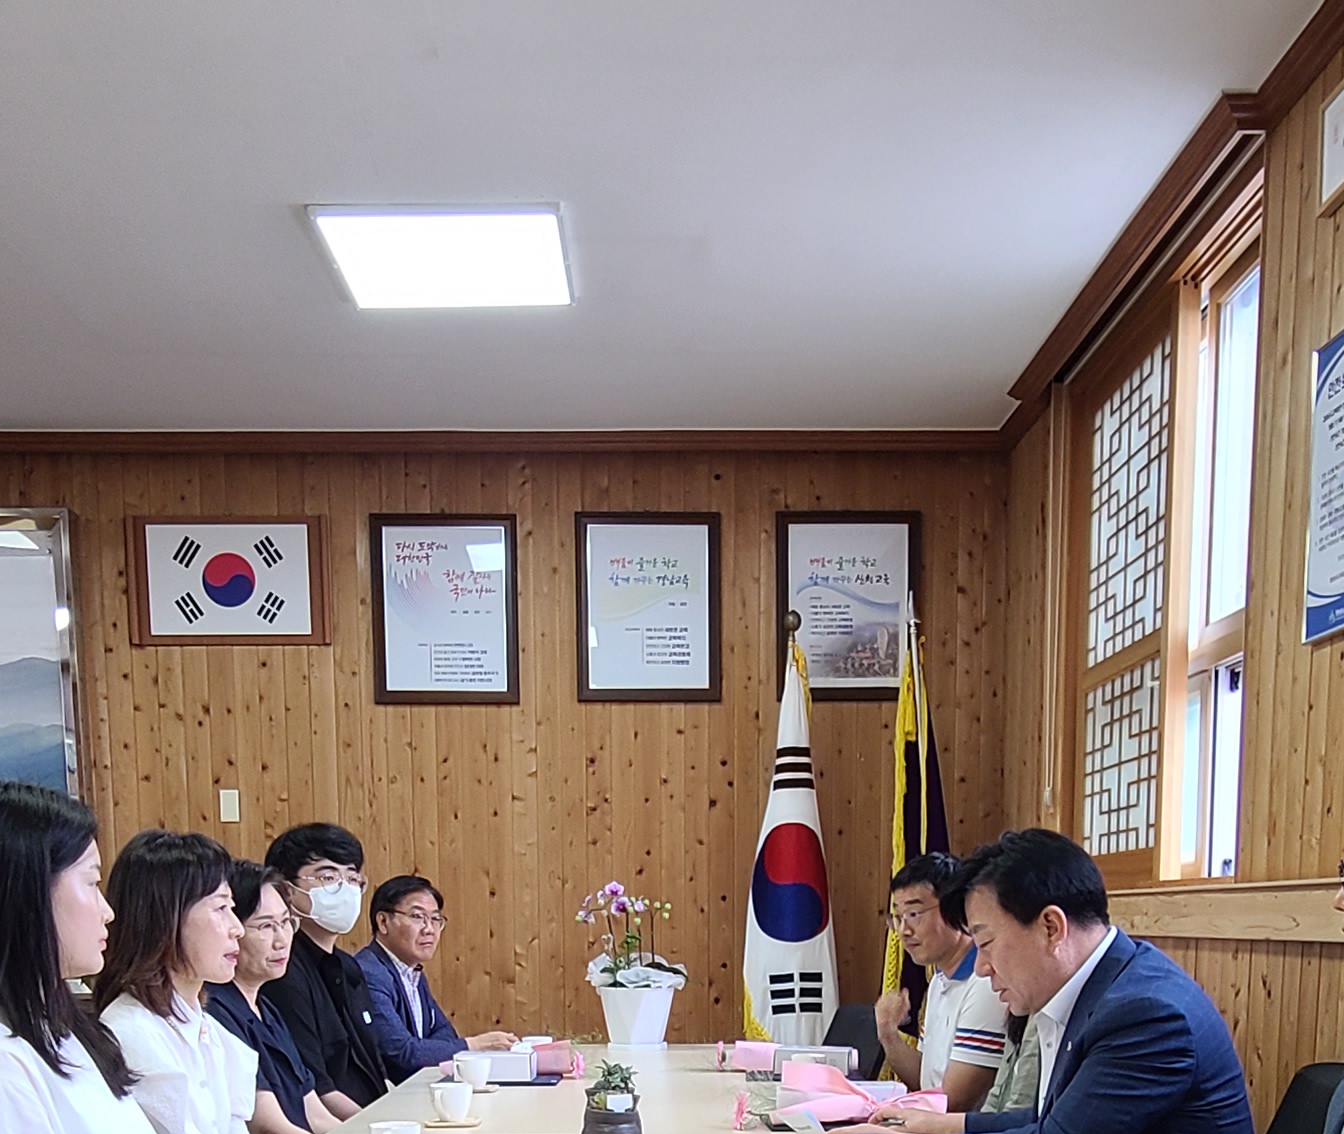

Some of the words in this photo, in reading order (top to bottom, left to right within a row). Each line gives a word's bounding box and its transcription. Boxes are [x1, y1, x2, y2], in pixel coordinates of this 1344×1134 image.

[395, 541, 415, 552] 다시
[395, 552, 432, 567] 대한민국
[661, 556, 678, 570] 학교
[860, 556, 877, 569] 학교
[443, 569, 465, 584] 함께
